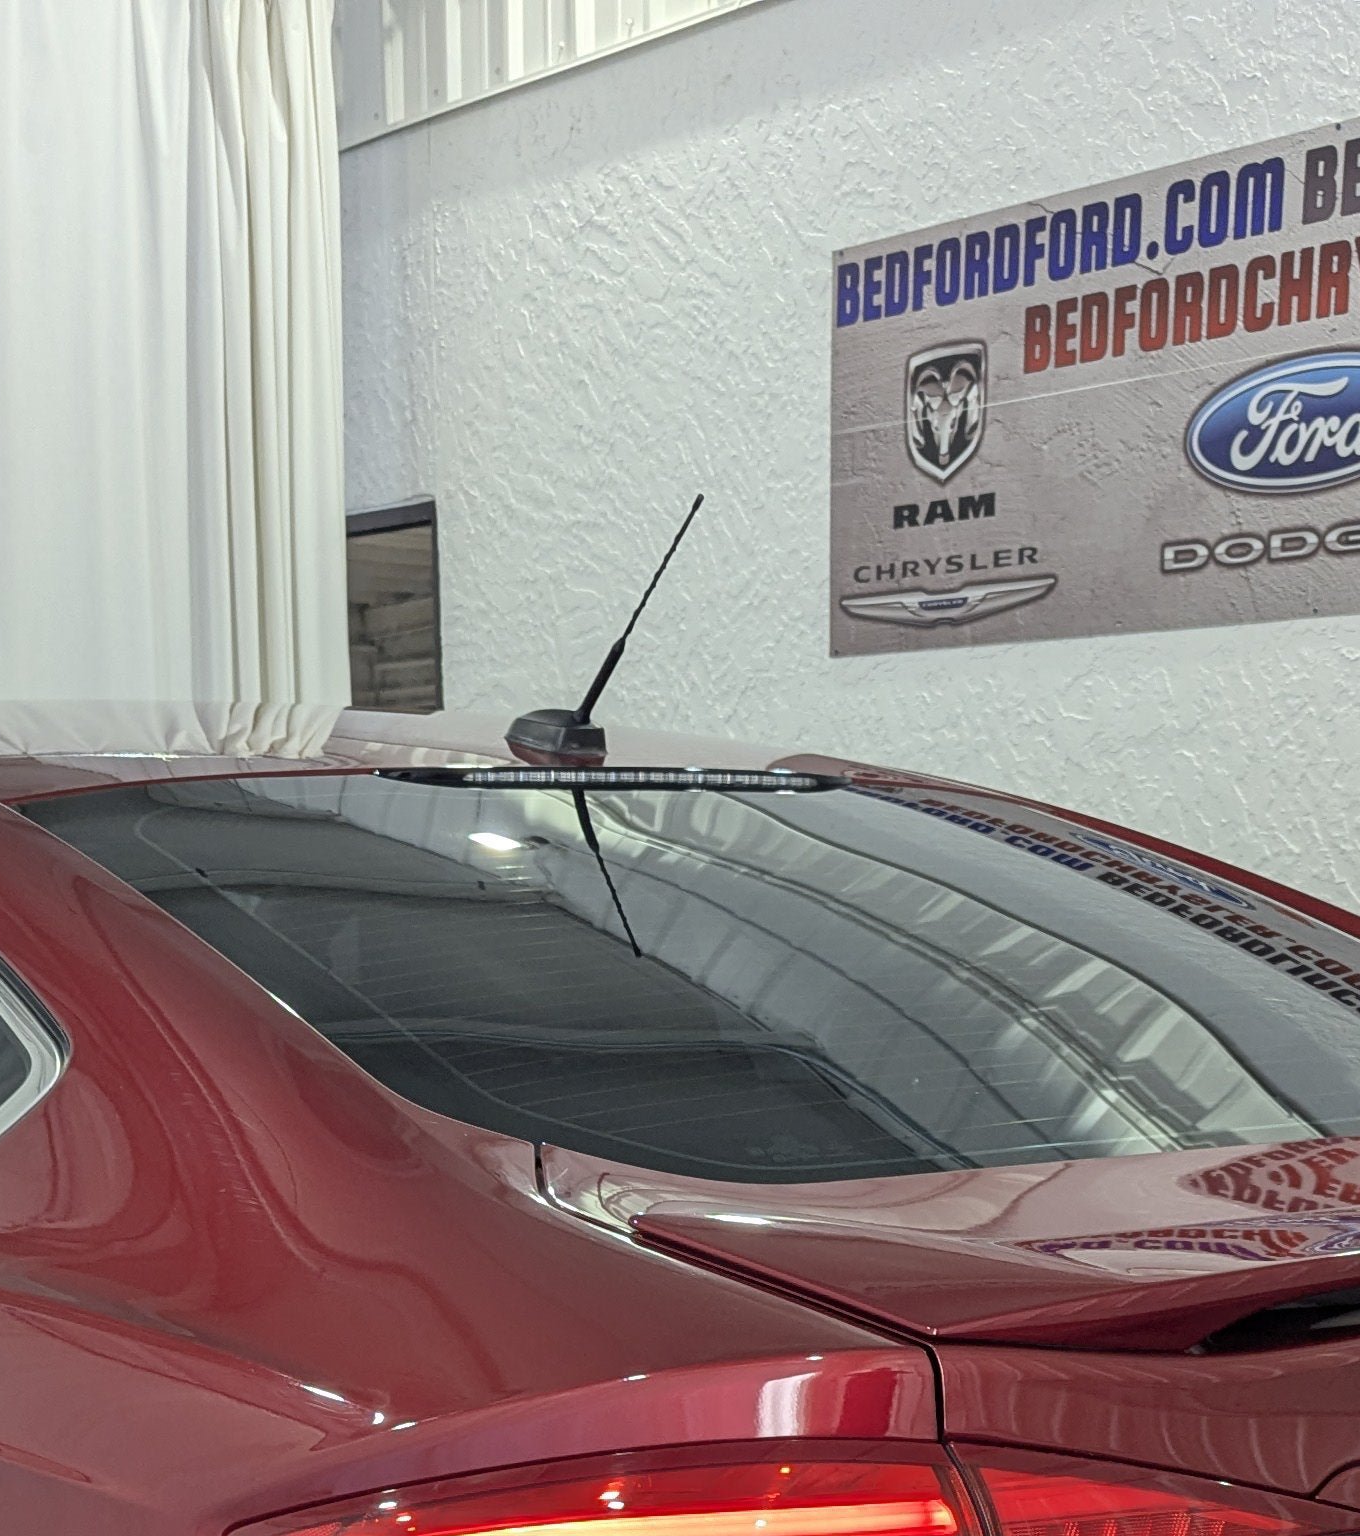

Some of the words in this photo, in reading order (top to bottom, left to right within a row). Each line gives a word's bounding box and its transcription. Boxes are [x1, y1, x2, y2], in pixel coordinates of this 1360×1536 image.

[836, 157, 1285, 328] BEDFORDFORD.COM
[893, 492, 996, 529] RAM
[852, 546, 1039, 584] CHRYSLER
